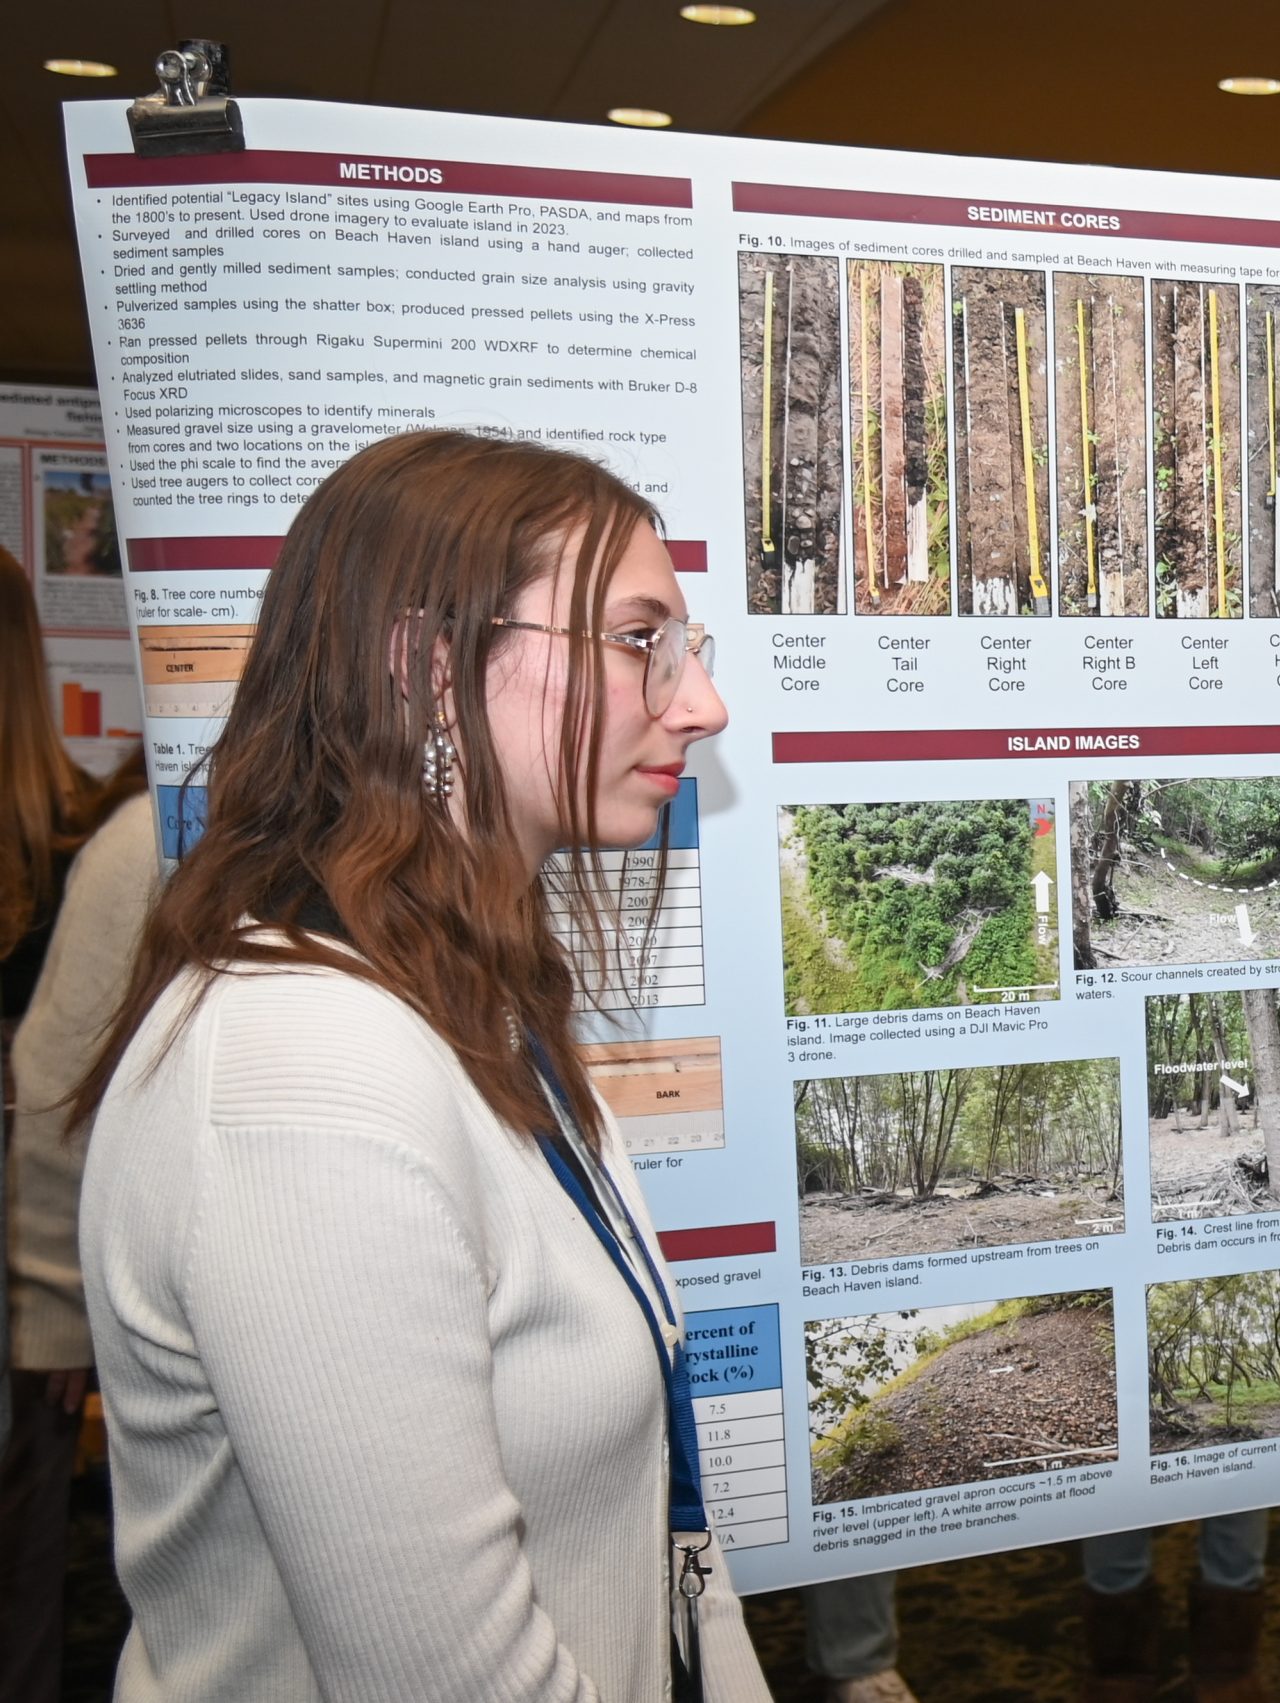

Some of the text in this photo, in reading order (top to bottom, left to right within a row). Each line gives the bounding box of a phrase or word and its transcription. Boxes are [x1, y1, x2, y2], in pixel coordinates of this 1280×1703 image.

[339, 162, 442, 184] METHODS
[112, 193, 167, 206] Identified
[171, 191, 223, 207] potential
[336, 194, 368, 207] sites
[373, 196, 409, 212] using
[414, 197, 463, 214] Google
[468, 200, 503, 214] Earth
[508, 203, 534, 218] Pro,
[539, 205, 591, 221] PASDA,
[596, 210, 620, 221] and
[625, 213, 659, 226] maps
[663, 213, 692, 225] from
[967, 205, 1120, 230] SEDIMENT CORES
[738, 233, 762, 248] Fig.
[767, 235, 785, 247] 10.
[790, 236, 834, 251] Images
[838, 239, 850, 250] of
[853, 241, 908, 254] sediment
[911, 246, 944, 256] cores
[947, 247, 982, 259] drilled
[986, 250, 1007, 260] and
[1011, 252, 1059, 264] sampled
[1063, 255, 1073, 265] at
[1077, 254, 1112, 266] Beach
[1116, 257, 1151, 269] Haven
[1154, 260, 1176, 271] with
[1180, 263, 1235, 277] measuring
[1239, 265, 1262, 278] tape
[1265, 266, 1279, 277] for
[125, 403, 435, 419] Used polarizing microscopes to identify minerals
[771, 633, 826, 647] Center
[877, 635, 930, 649] Center
[980, 635, 1031, 649] Center
[1084, 635, 1133, 649] Center
[1181, 635, 1229, 649] Center
[773, 655, 825, 669] Middle
[891, 656, 917, 670] Tail
[987, 656, 1026, 673] Right
[1082, 655, 1135, 673] Right B
[1192, 655, 1218, 669] Left
[781, 676, 819, 690] Core
[886, 678, 924, 692] Core
[988, 677, 1024, 691] Core
[1091, 676, 1127, 690] Core
[1188, 676, 1222, 689] Core
[1008, 734, 1139, 751] ISLAND IMAGES
[1038, 915, 1048, 945] Flow
[1075, 973, 1097, 986] Fig.
[1100, 972, 1117, 983] 12.
[1120, 971, 1152, 982] Scour
[1155, 967, 1203, 980] channels
[1206, 964, 1245, 977] created
[1249, 964, 1261, 976] by
[1001, 991, 1030, 1002] 20 m
[1075, 989, 1114, 1000] waters.
[786, 1005, 1040, 1032] Fig. 11. Large debris dams on Beach Haven
[787, 1019, 1048, 1046] island. Image collected using a DJI Mavic Pro
[787, 1050, 835, 1062] 3 drone.
[1154, 1058, 1248, 1075] Floodwater level
[656, 1089, 681, 1100] BARK
[1156, 1227, 1177, 1240] Fig.
[1180, 1225, 1196, 1236] 14.
[1203, 1222, 1232, 1234] Crest
[1235, 1221, 1253, 1230] line
[1256, 1218, 1279, 1228] from
[709, 1403, 726, 1415] 7.5
[708, 1429, 731, 1442] 11.8
[708, 1455, 733, 1468] 10.0
[1150, 1459, 1171, 1471] Fig.
[1174, 1455, 1190, 1466] 16.
[1193, 1451, 1225, 1463] Image
[1227, 1447, 1238, 1458] of
[1240, 1442, 1276, 1456] current
[1149, 1459, 1255, 1485] Beach Haven island.
[713, 1482, 730, 1493] 7.2
